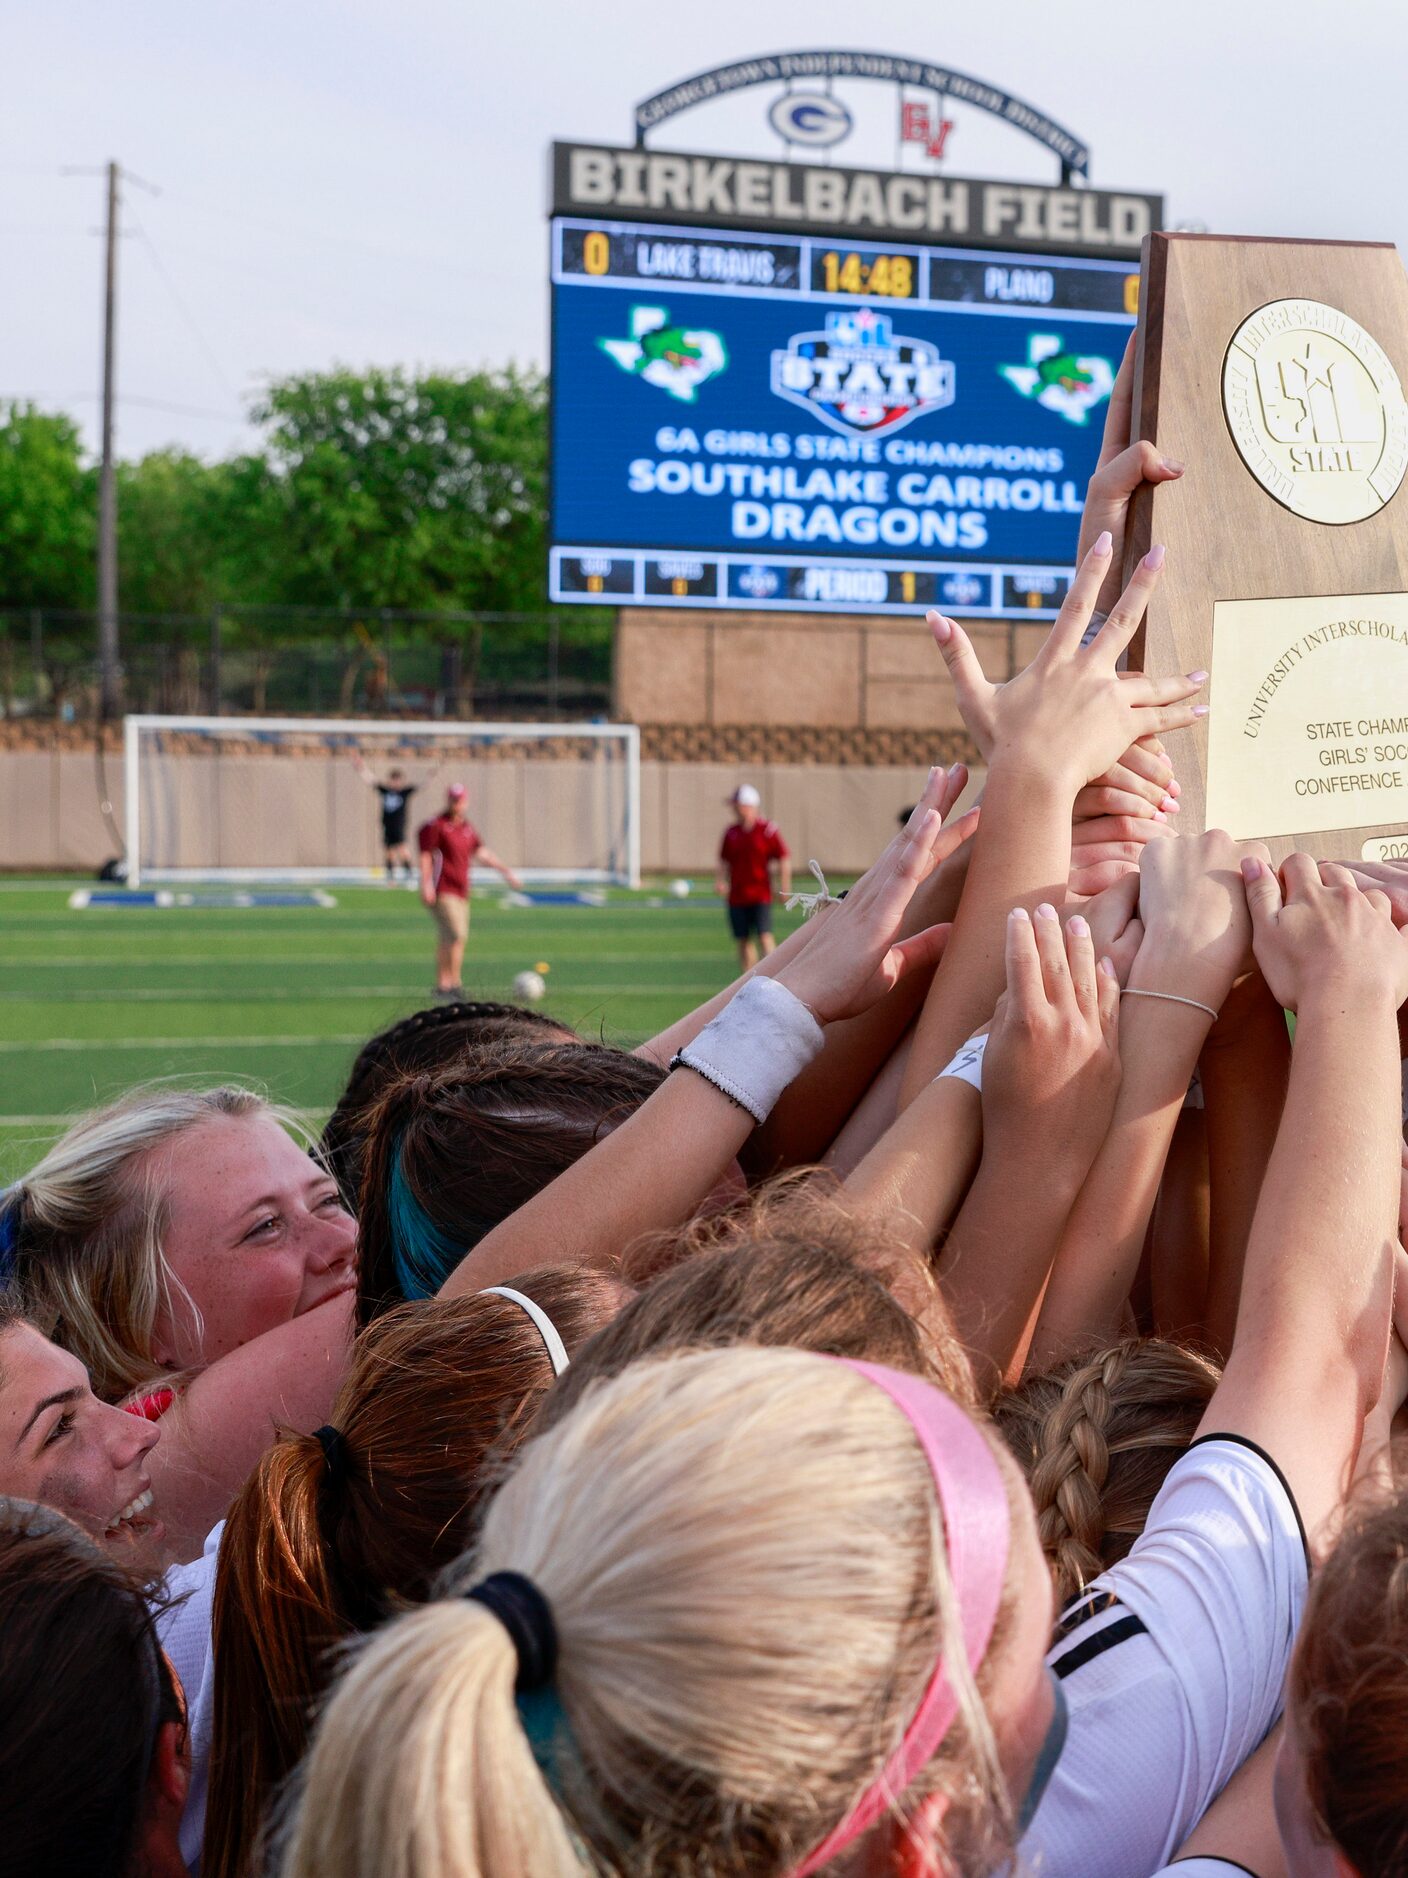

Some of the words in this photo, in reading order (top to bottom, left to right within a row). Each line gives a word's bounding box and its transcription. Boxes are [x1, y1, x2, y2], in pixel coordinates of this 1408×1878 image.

[569, 148, 970, 236] BIRKELBACH
[983, 192, 1151, 249] FIELD
[583, 231, 609, 276] 0
[636, 241, 695, 278] LAKE
[823, 252, 912, 298] 14:48
[985, 267, 1054, 303] PLANO
[781, 357, 947, 399] STATE
[656, 427, 699, 453] 6A
[704, 432, 790, 459] GIRLS
[796, 436, 881, 464] STATE
[886, 441, 1064, 473] CHAMPIONS
[1290, 447, 1363, 473] STATE
[629, 459, 888, 501] SOUTHLAKE
[898, 477, 1085, 513] CARROLL
[731, 502, 988, 549] DRAGONS
[1244, 642, 1303, 739] UNIVERSITY
[1306, 721, 1353, 741] STATE
[1319, 746, 1369, 767] GIRLS'
[1294, 771, 1403, 797] CONFERENCE
